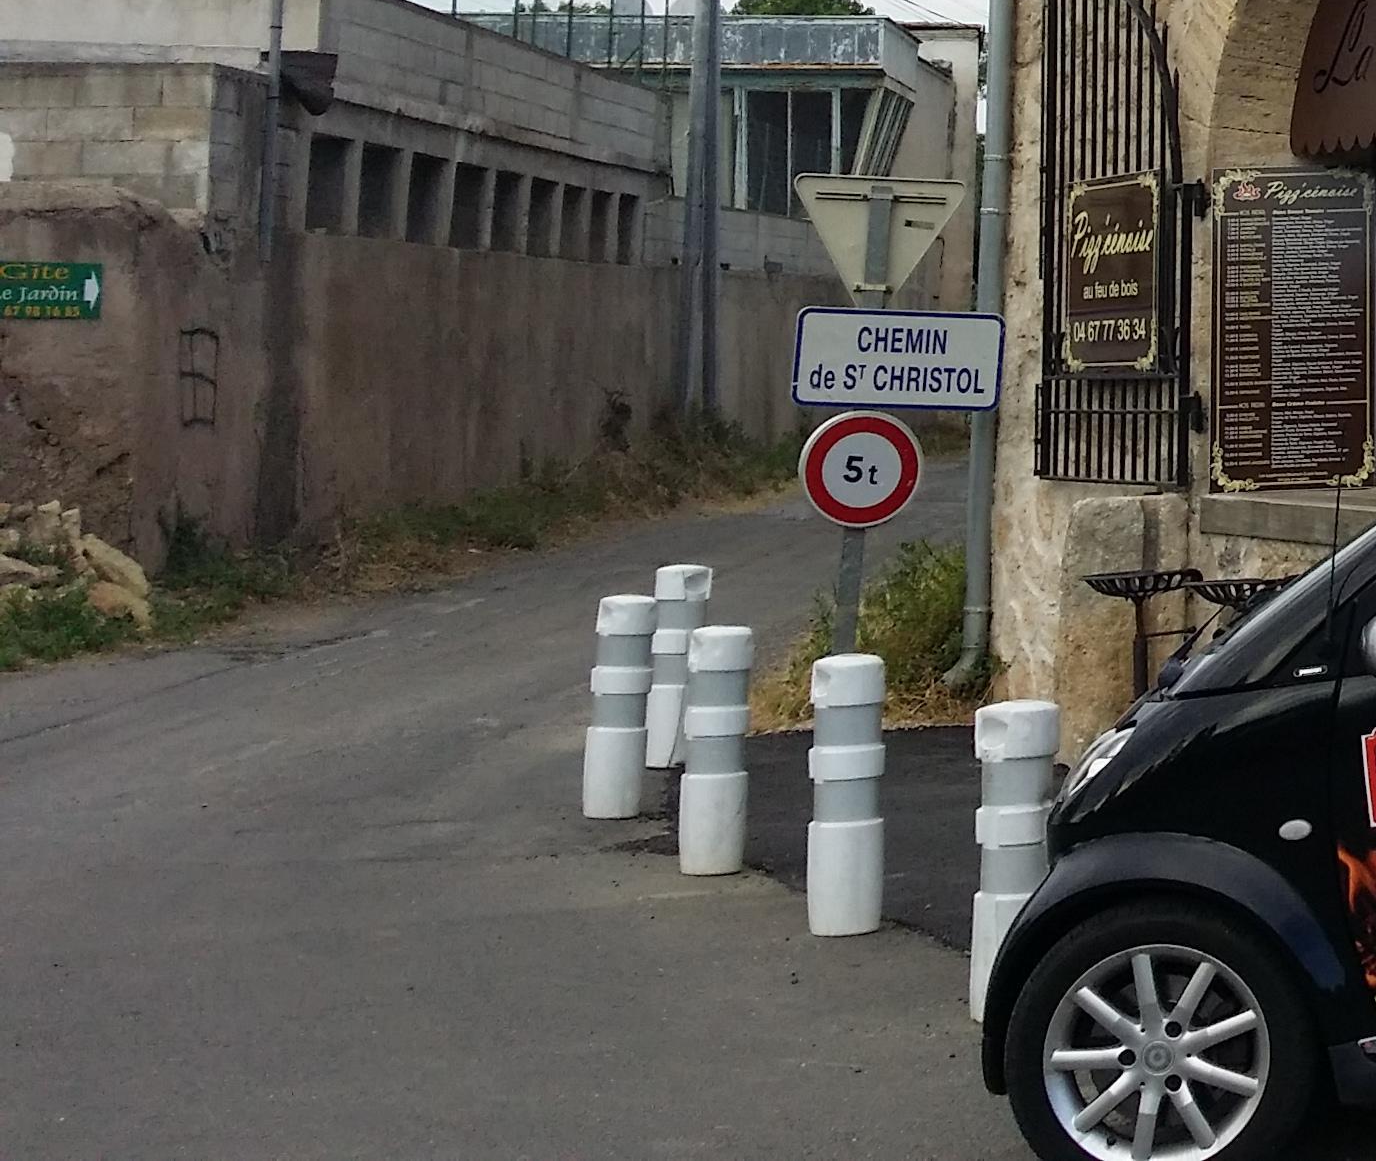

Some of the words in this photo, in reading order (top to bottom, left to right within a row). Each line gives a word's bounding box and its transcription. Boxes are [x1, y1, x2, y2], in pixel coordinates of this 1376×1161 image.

[0, 287, 12, 300] e
[17, 285, 78, 303] Jardin
[1083, 285, 1093, 300] au
[1095, 281, 1107, 299] feu
[1109, 280, 1120, 298] de
[1121, 279, 1139, 297] bois
[857, 326, 948, 355] CHEMIN
[1074, 322, 1086, 342] 04
[1088, 320, 1100, 342] 67
[1102, 319, 1115, 341] 77
[1117, 318, 1131, 340] 36
[1133, 318, 1146, 339] 34
[809, 363, 835, 390] de
[873, 365, 985, 394] CHRISTOL
